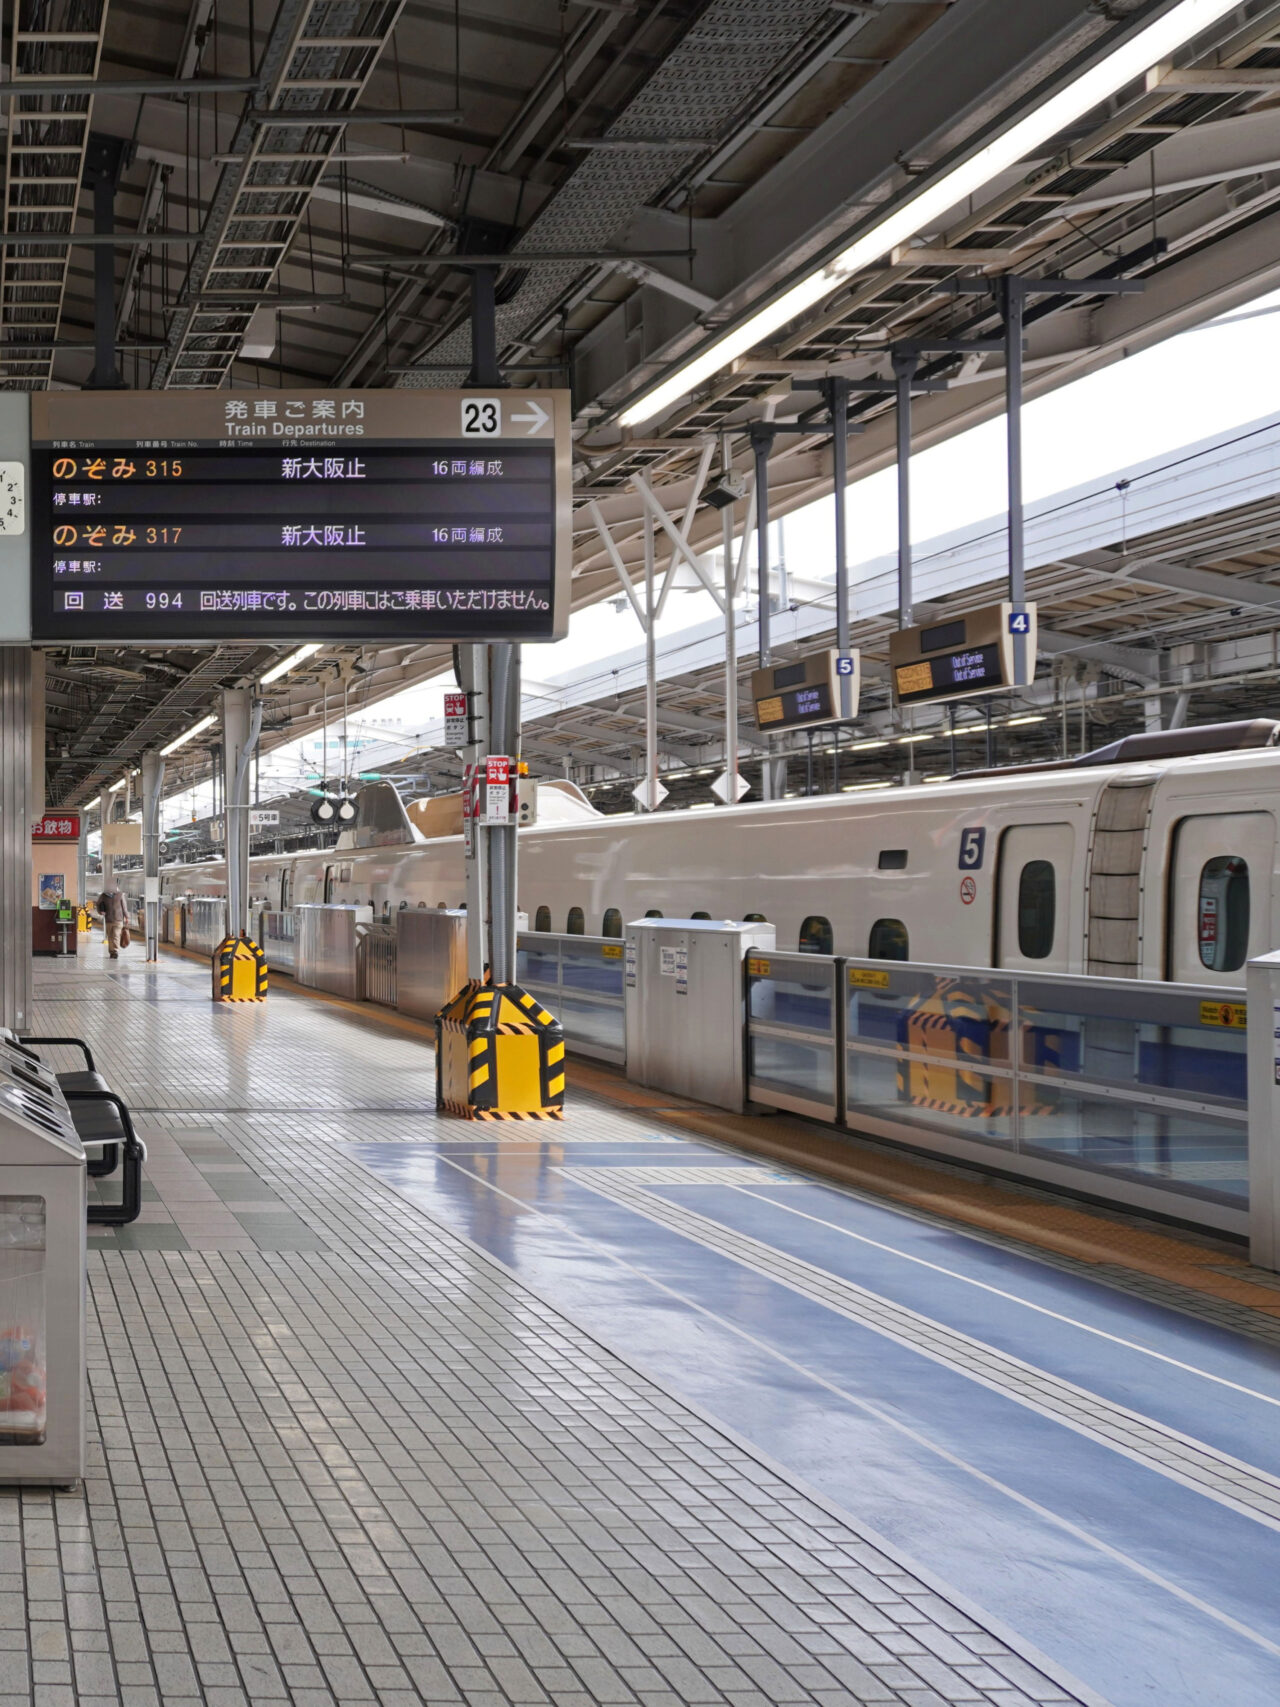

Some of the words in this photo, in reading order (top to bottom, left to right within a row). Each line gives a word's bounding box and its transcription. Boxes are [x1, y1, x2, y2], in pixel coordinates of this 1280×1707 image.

[225, 400, 365, 419] 発車ご案内
[465, 404, 498, 433] 23
[225, 422, 267, 436] Train
[272, 422, 365, 437] Departures
[53, 457, 137, 480] のぞみ
[146, 461, 182, 477] 315
[282, 458, 366, 479] 新大阪止
[433, 461, 504, 476] 16両編成
[53, 525, 137, 547] のぞみ
[146, 528, 182, 544] 317
[282, 525, 366, 547] 新大阪止
[433, 528, 504, 543] 16両編成
[146, 593, 183, 609] 994
[1012, 615, 1027, 631] 4
[840, 660, 850, 674] 5
[964, 832, 981, 861] 5
